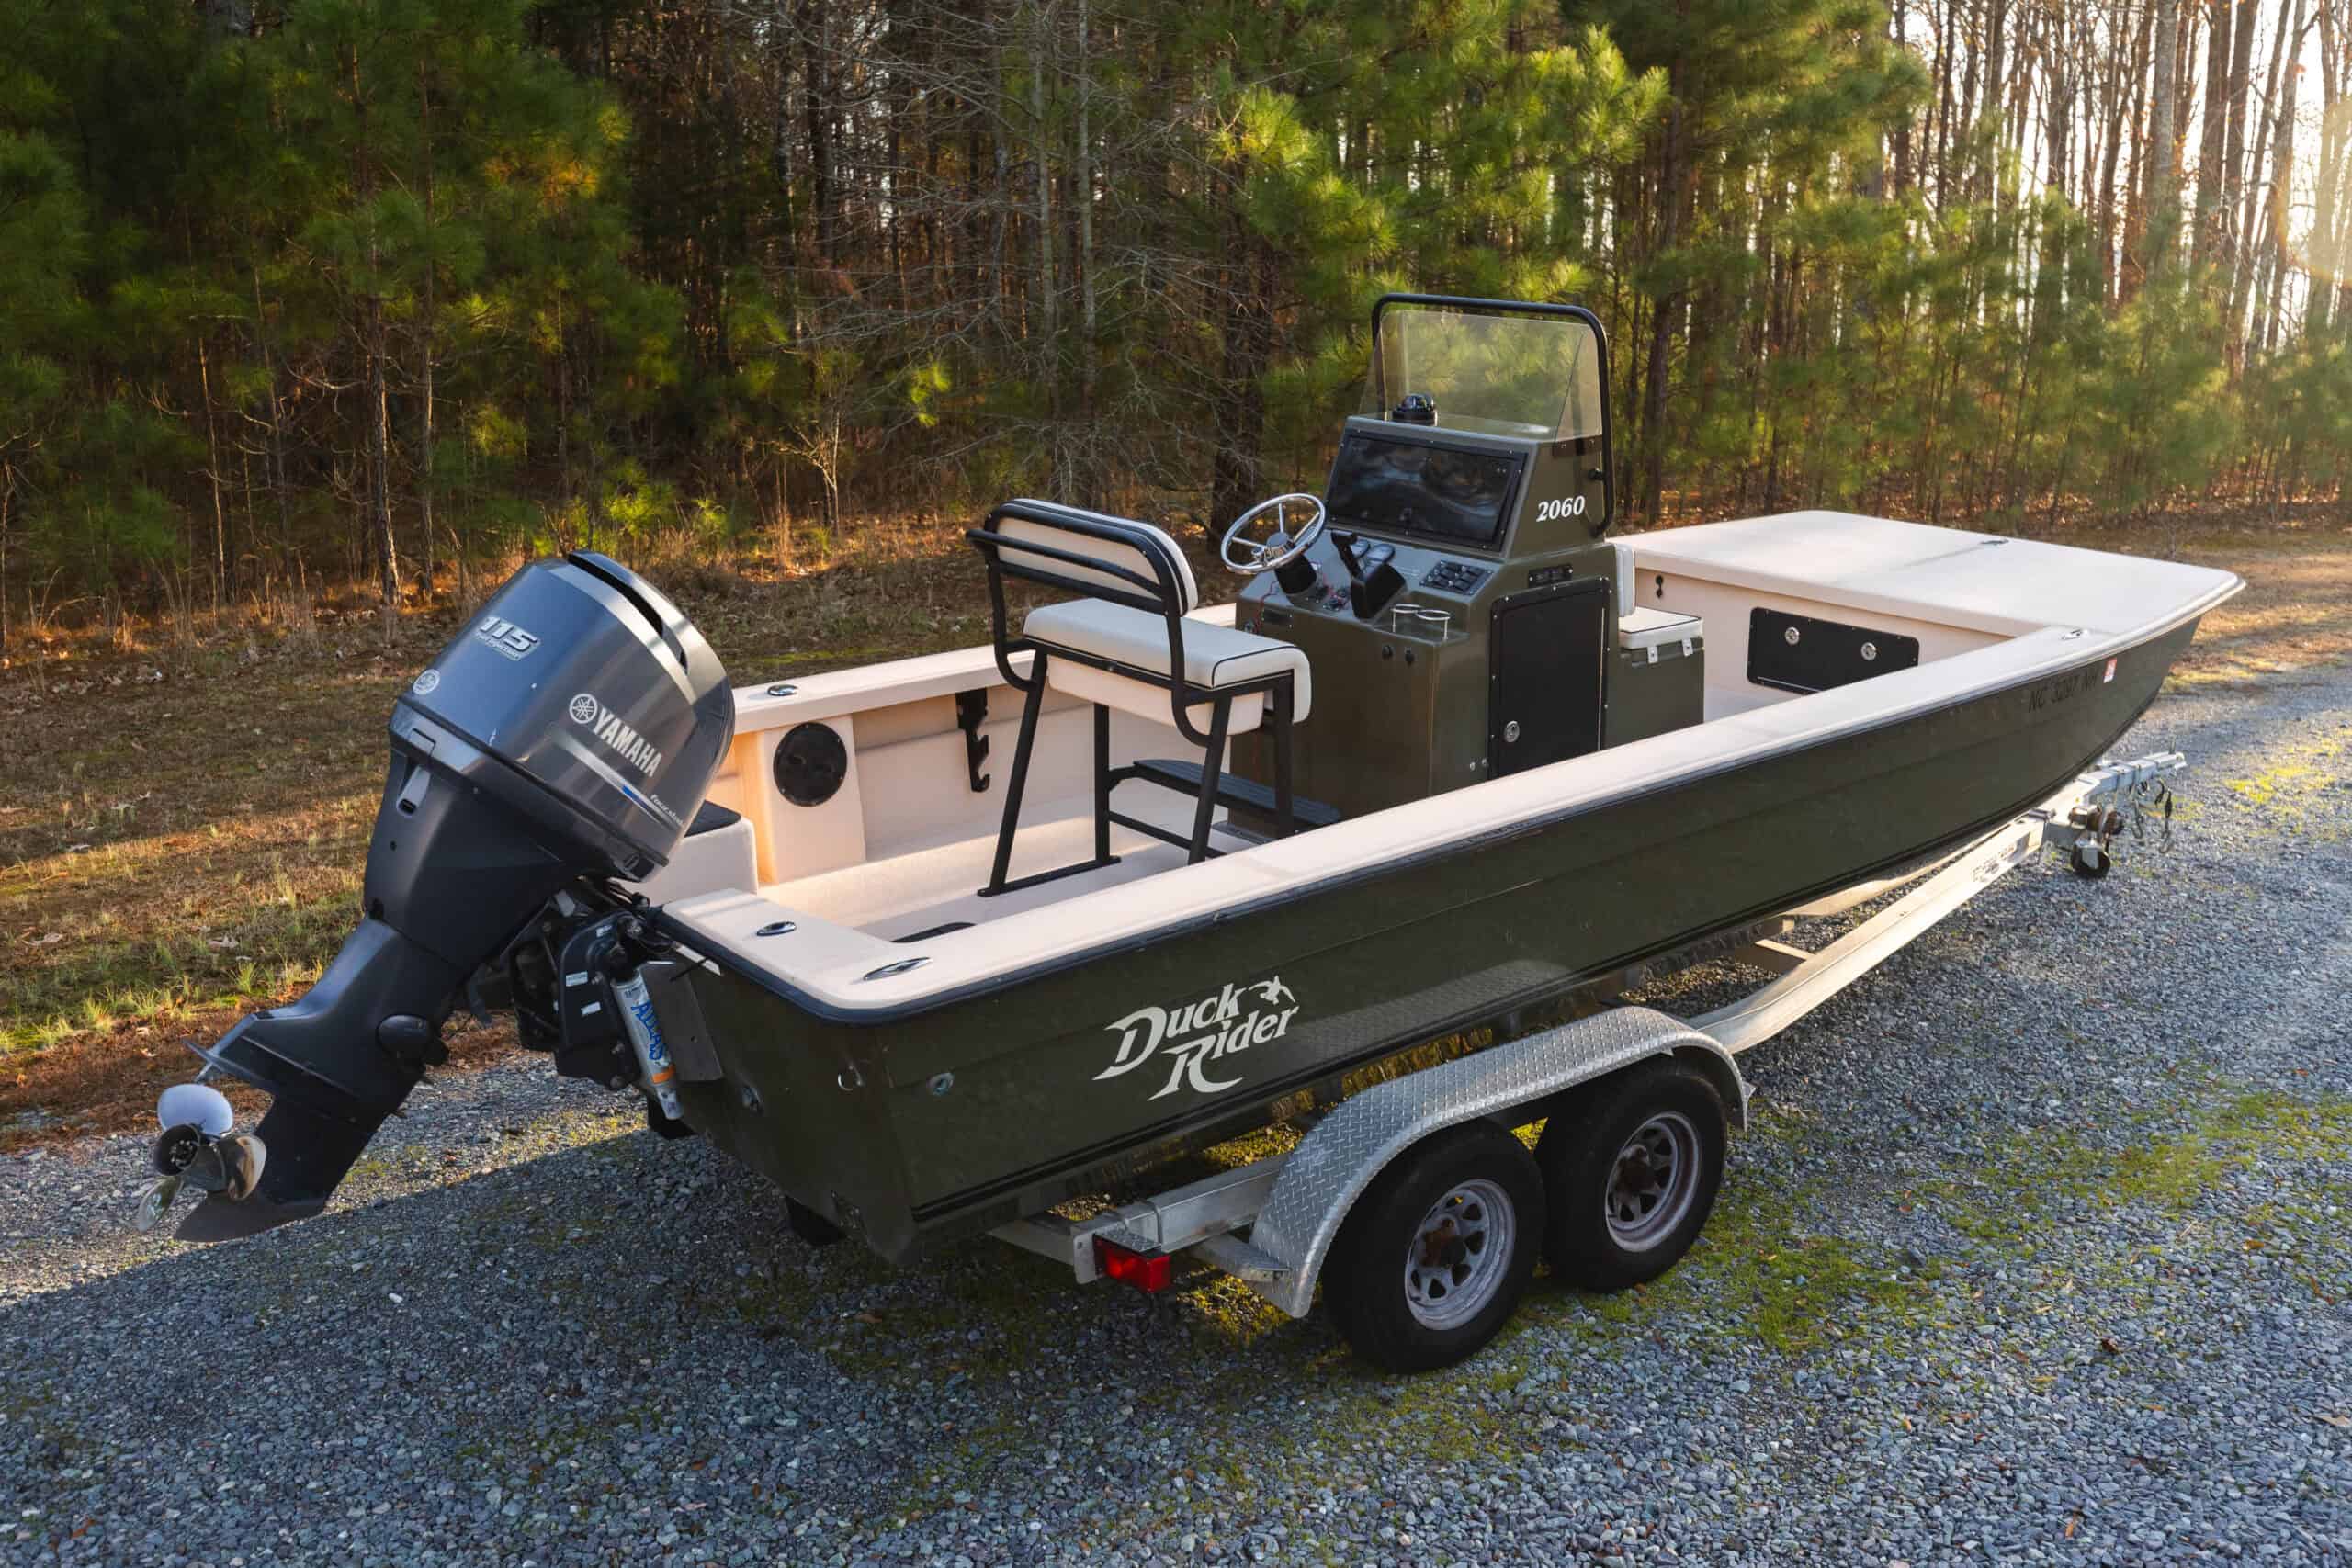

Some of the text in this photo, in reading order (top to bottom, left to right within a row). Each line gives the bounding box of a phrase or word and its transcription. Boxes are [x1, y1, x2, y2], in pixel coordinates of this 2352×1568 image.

[1535, 495, 1586, 522] 2060
[479, 617, 538, 653] 115
[593, 706, 662, 778] YAMAHA
[1091, 982, 1247, 1081] Duck
[1146, 1005, 1300, 1101] Rider
